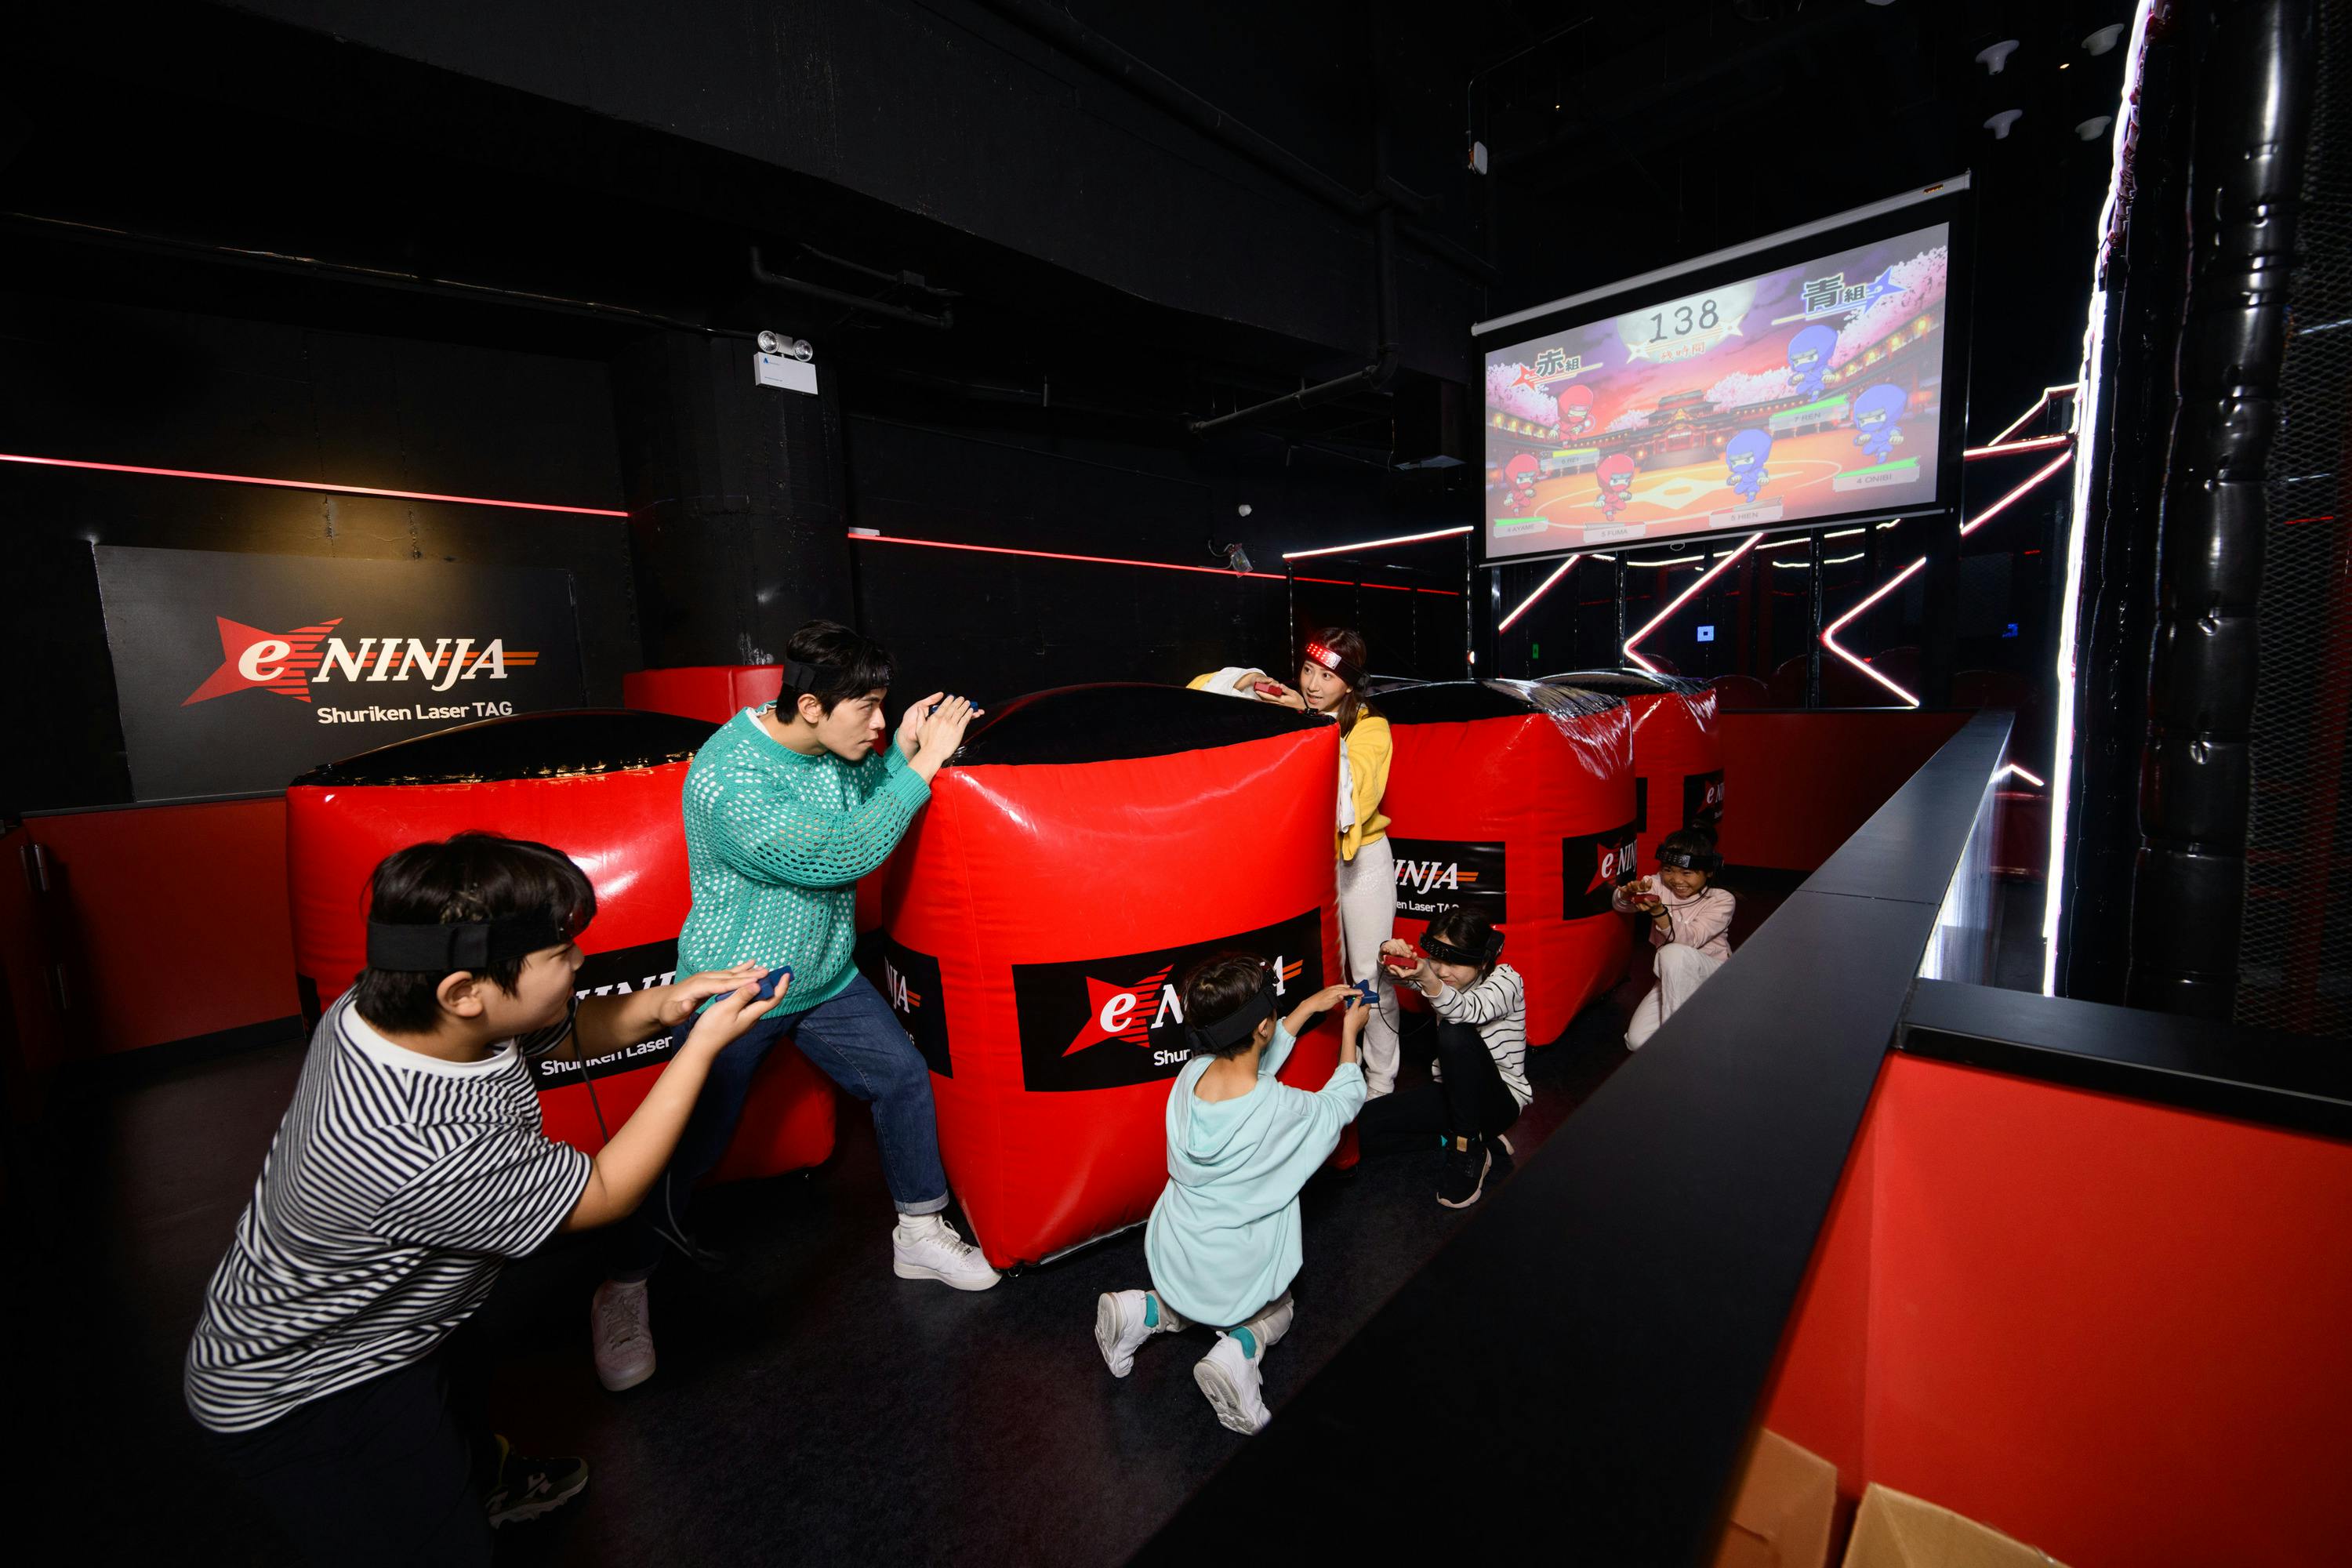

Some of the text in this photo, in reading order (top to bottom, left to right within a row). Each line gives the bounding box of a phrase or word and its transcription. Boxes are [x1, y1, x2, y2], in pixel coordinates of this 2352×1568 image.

[1803, 274, 1865, 313] 青組
[1648, 299, 1719, 344] 138
[1536, 350, 1581, 377] 赤組
[1864, 474, 1893, 483] ONIBI
[1607, 528, 1628, 537] FUMA
[317, 701, 513, 724] Shuriken Laser TAG
[1392, 858, 1459, 895] INJA
[1409, 900, 1436, 913] Laser
[626, 1036, 673, 1058] Laser
[1153, 1048, 1195, 1066] Shur
